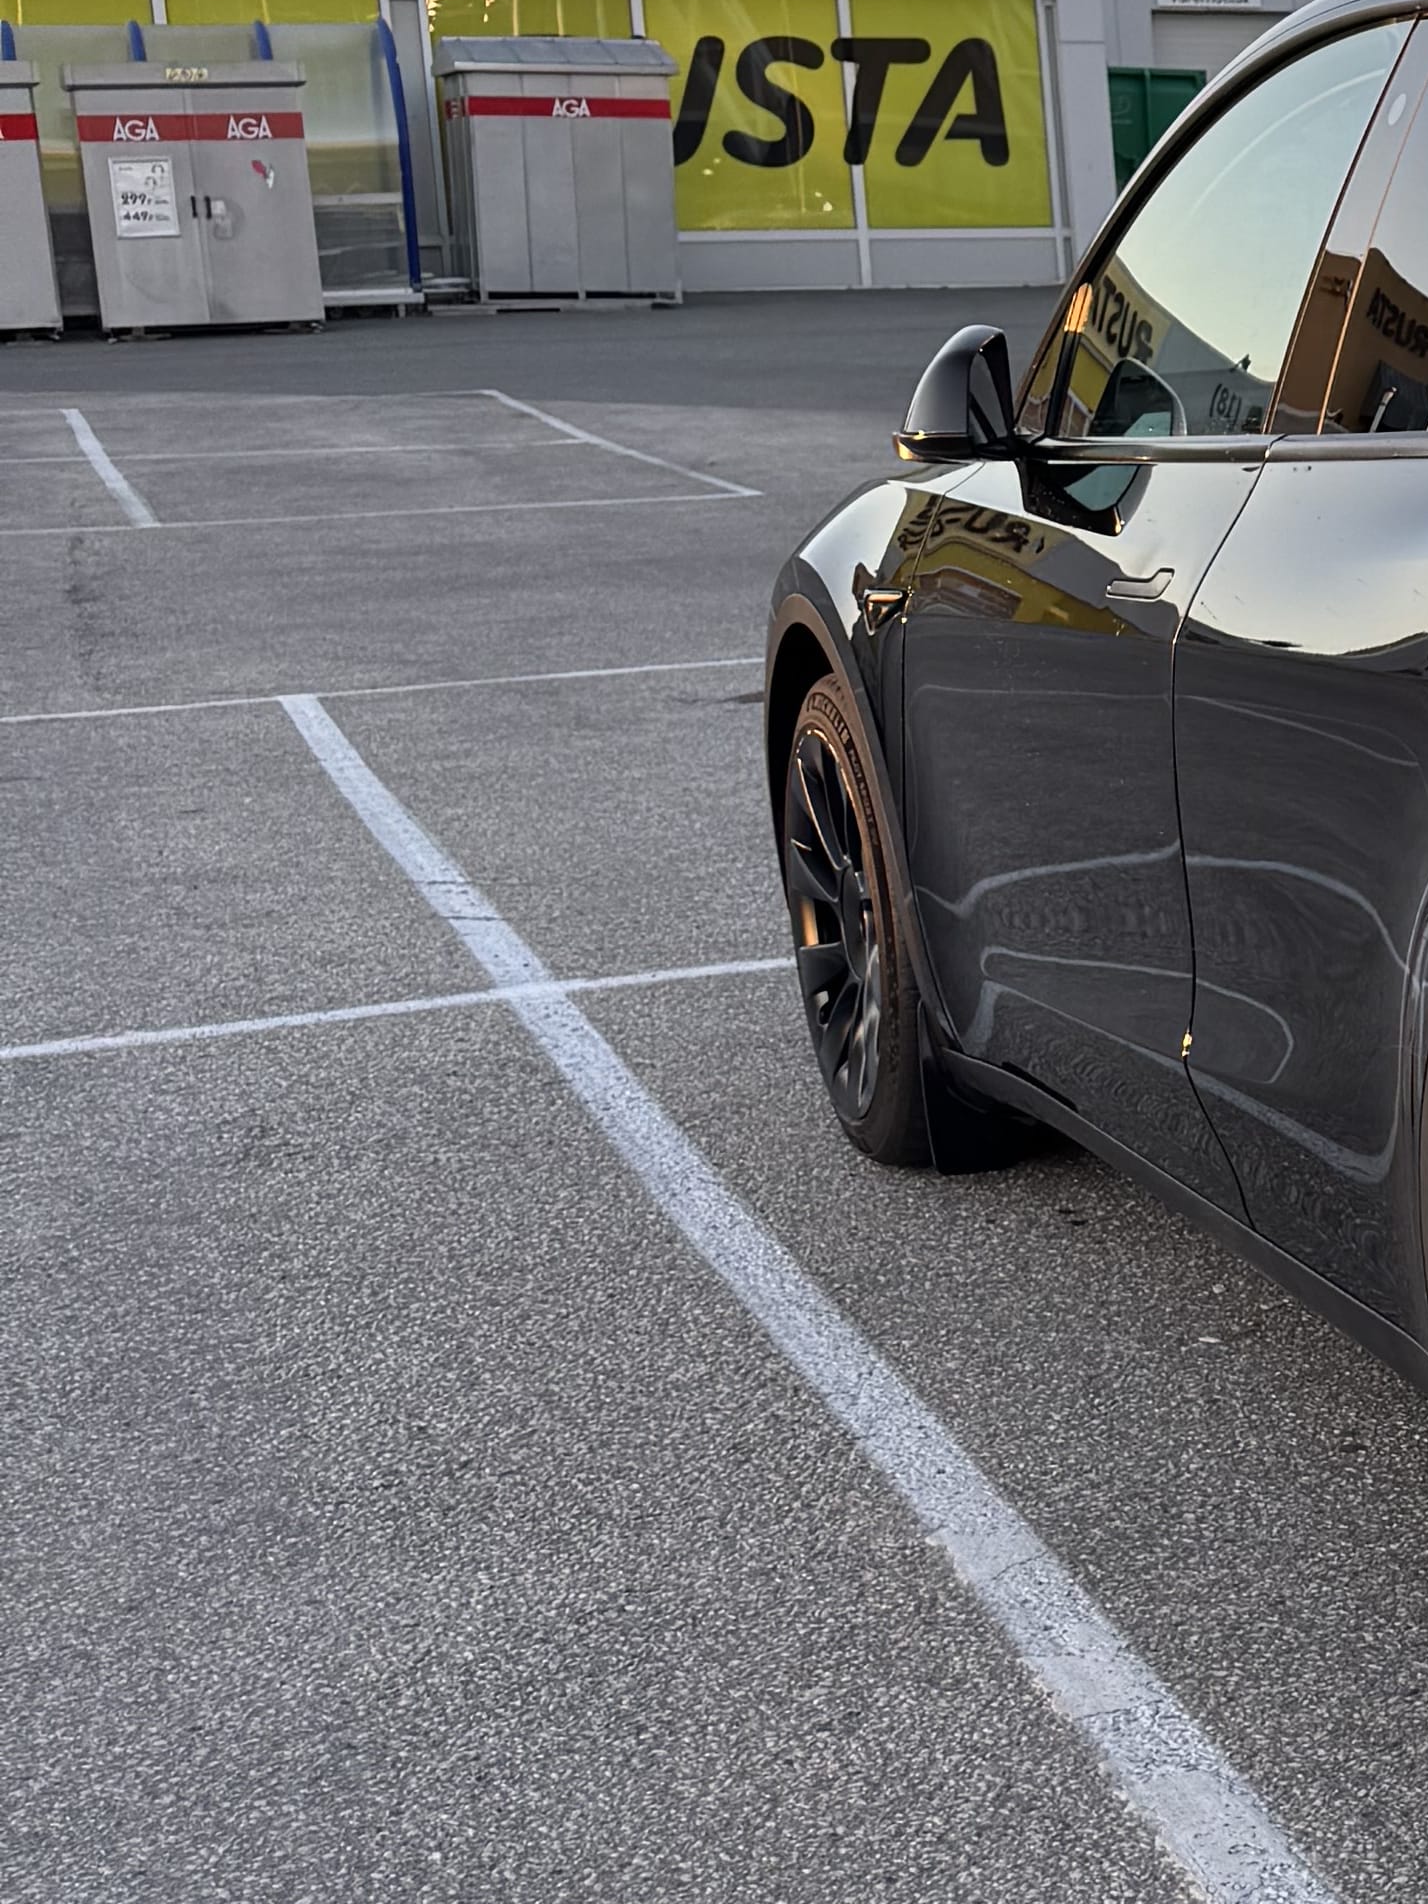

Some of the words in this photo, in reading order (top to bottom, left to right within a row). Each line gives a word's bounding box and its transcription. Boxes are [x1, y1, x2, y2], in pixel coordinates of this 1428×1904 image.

[551, 97, 591, 118] AGA
[113, 115, 160, 142] AGA
[227, 114, 273, 139] AGA
